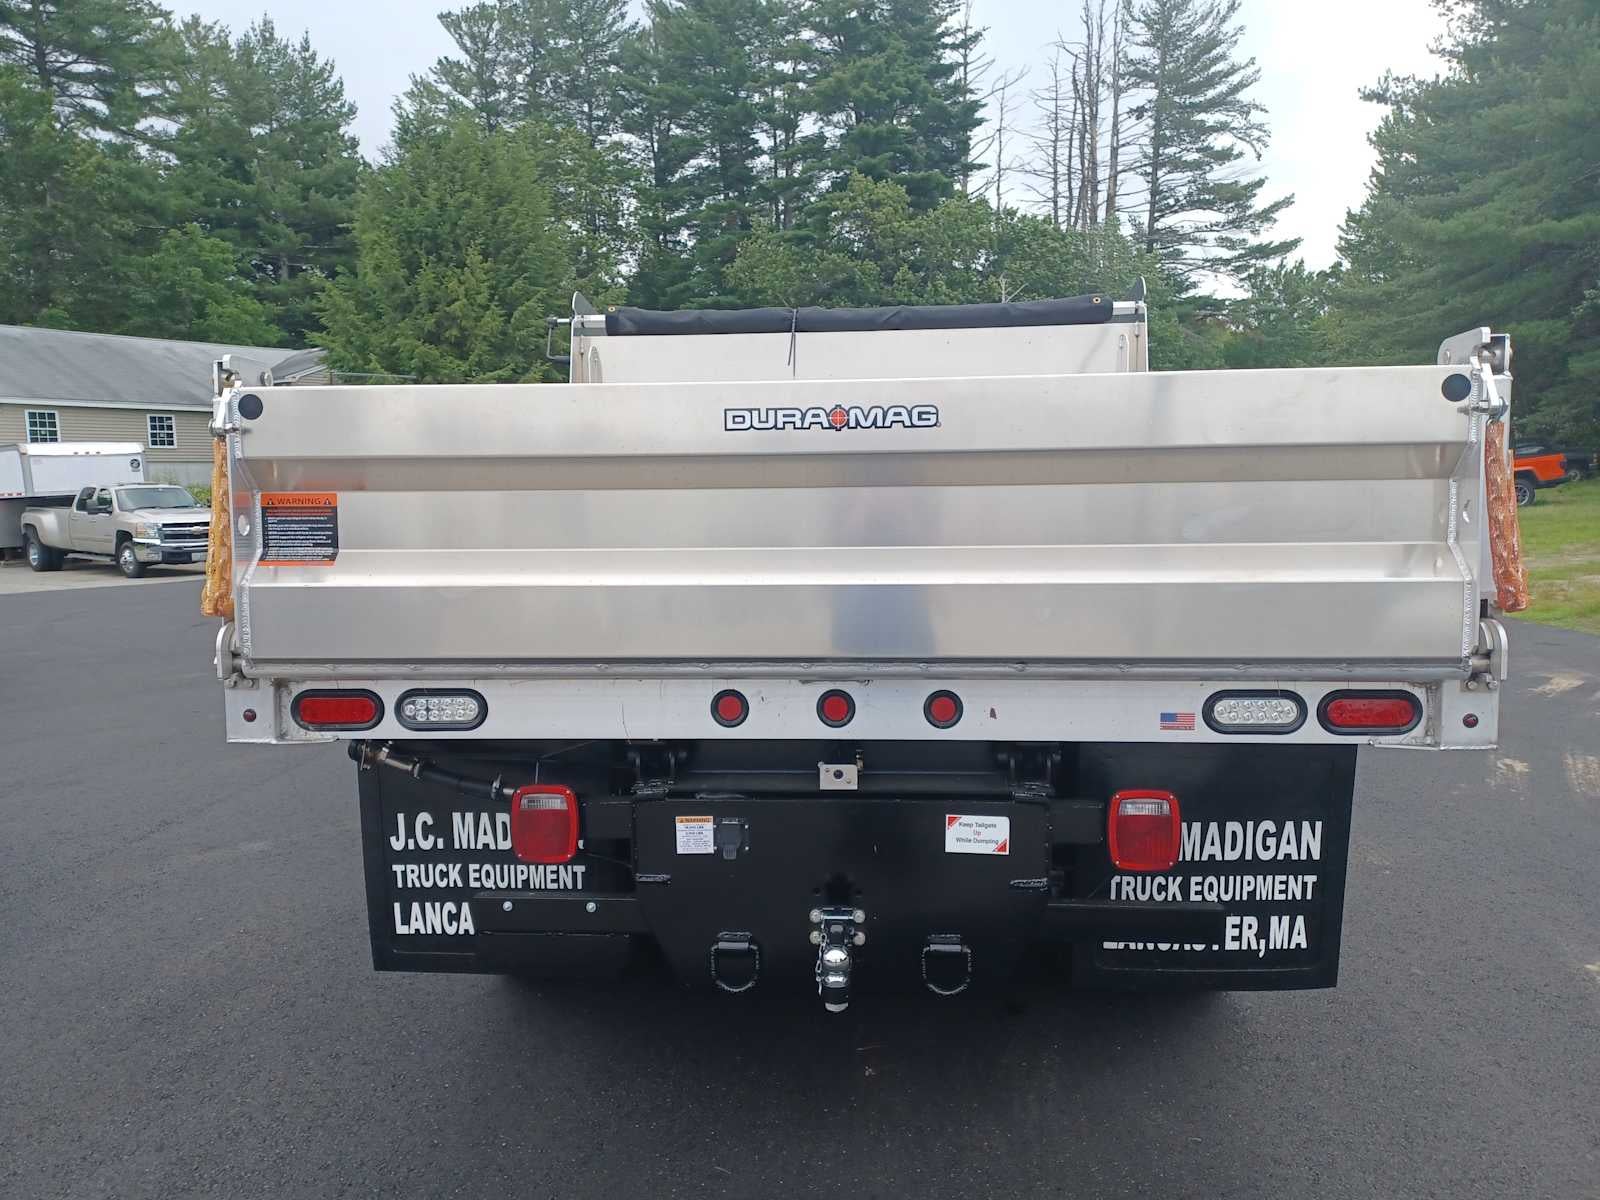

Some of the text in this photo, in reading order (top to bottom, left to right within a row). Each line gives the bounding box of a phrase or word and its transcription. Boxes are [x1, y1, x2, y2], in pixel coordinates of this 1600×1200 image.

[277, 497, 321, 505] WARNING
[390, 812, 444, 850] J.C.
[1178, 820, 1323, 861] MADIGAN
[391, 864, 586, 890] TRUCK EQUIPMENT
[1110, 875, 1318, 903] TRUCK EQUIPMENT
[394, 902, 475, 935] LANCA
